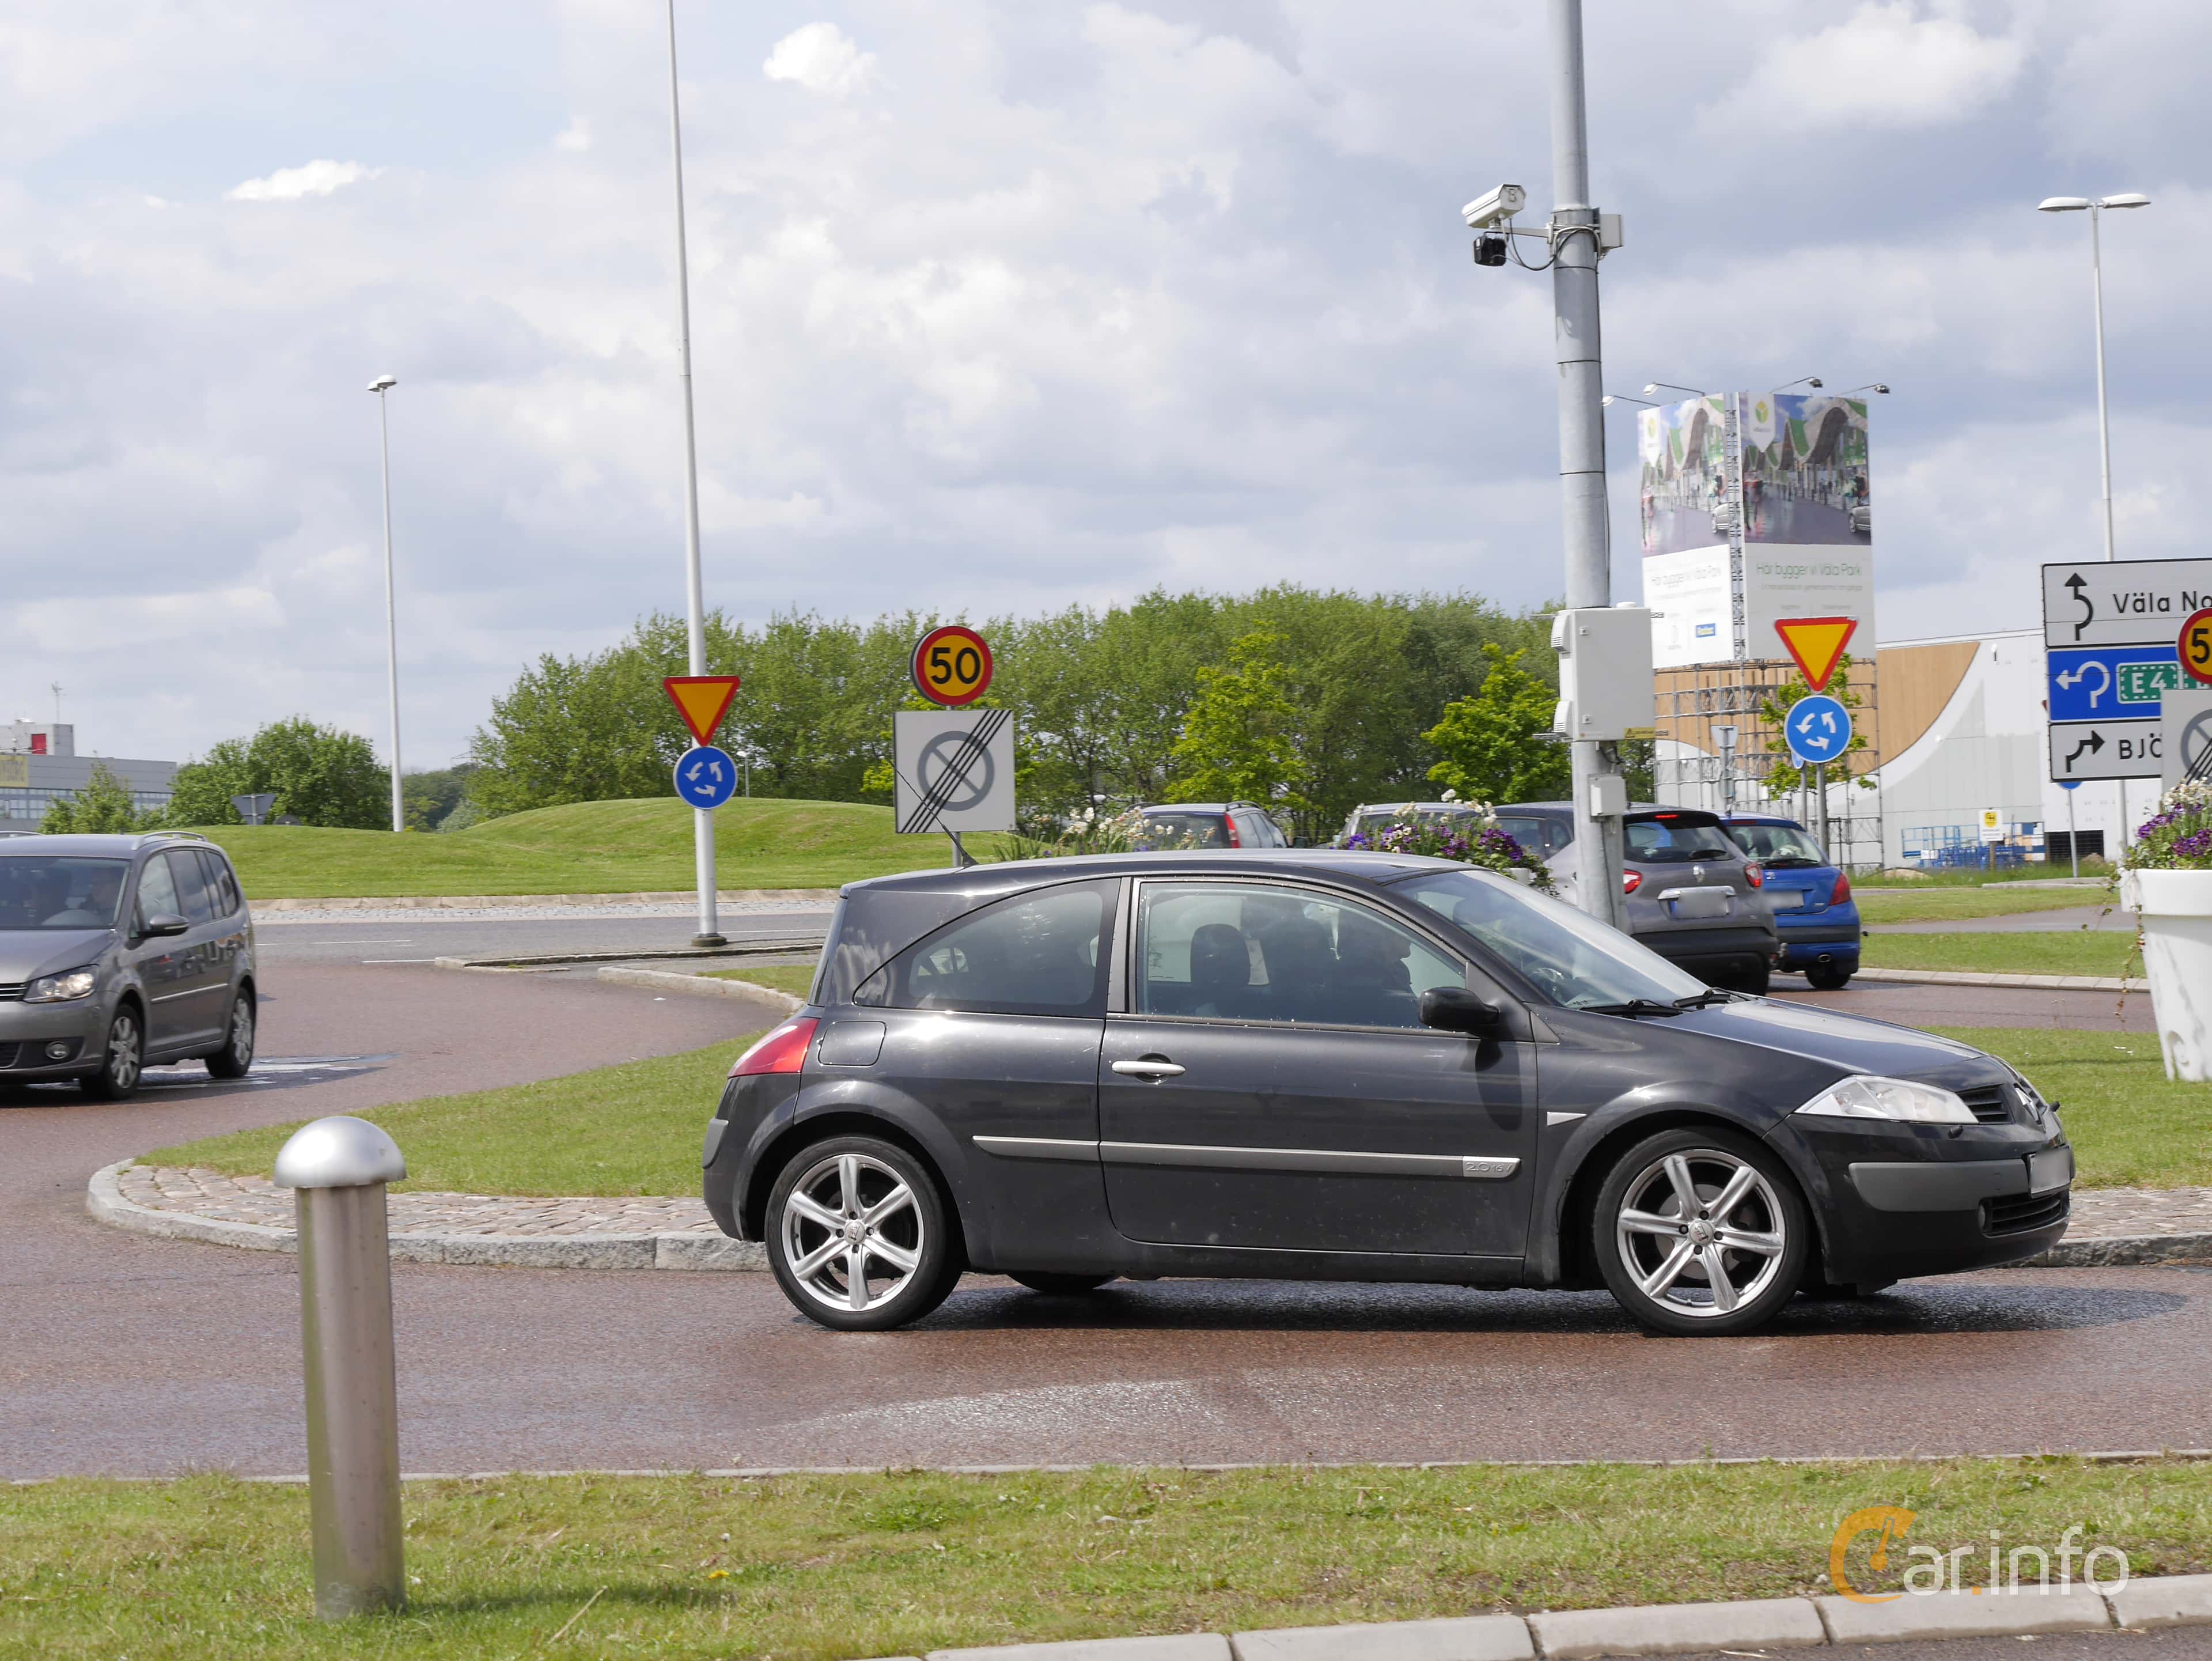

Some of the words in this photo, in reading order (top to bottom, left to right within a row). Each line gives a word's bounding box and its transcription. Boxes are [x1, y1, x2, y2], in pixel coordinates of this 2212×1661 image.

[2113, 592, 2170, 614] Väla
[930, 647, 980, 684] 50
[2132, 672, 2167, 694] E4
[2118, 732, 2161, 760] BJÖ
